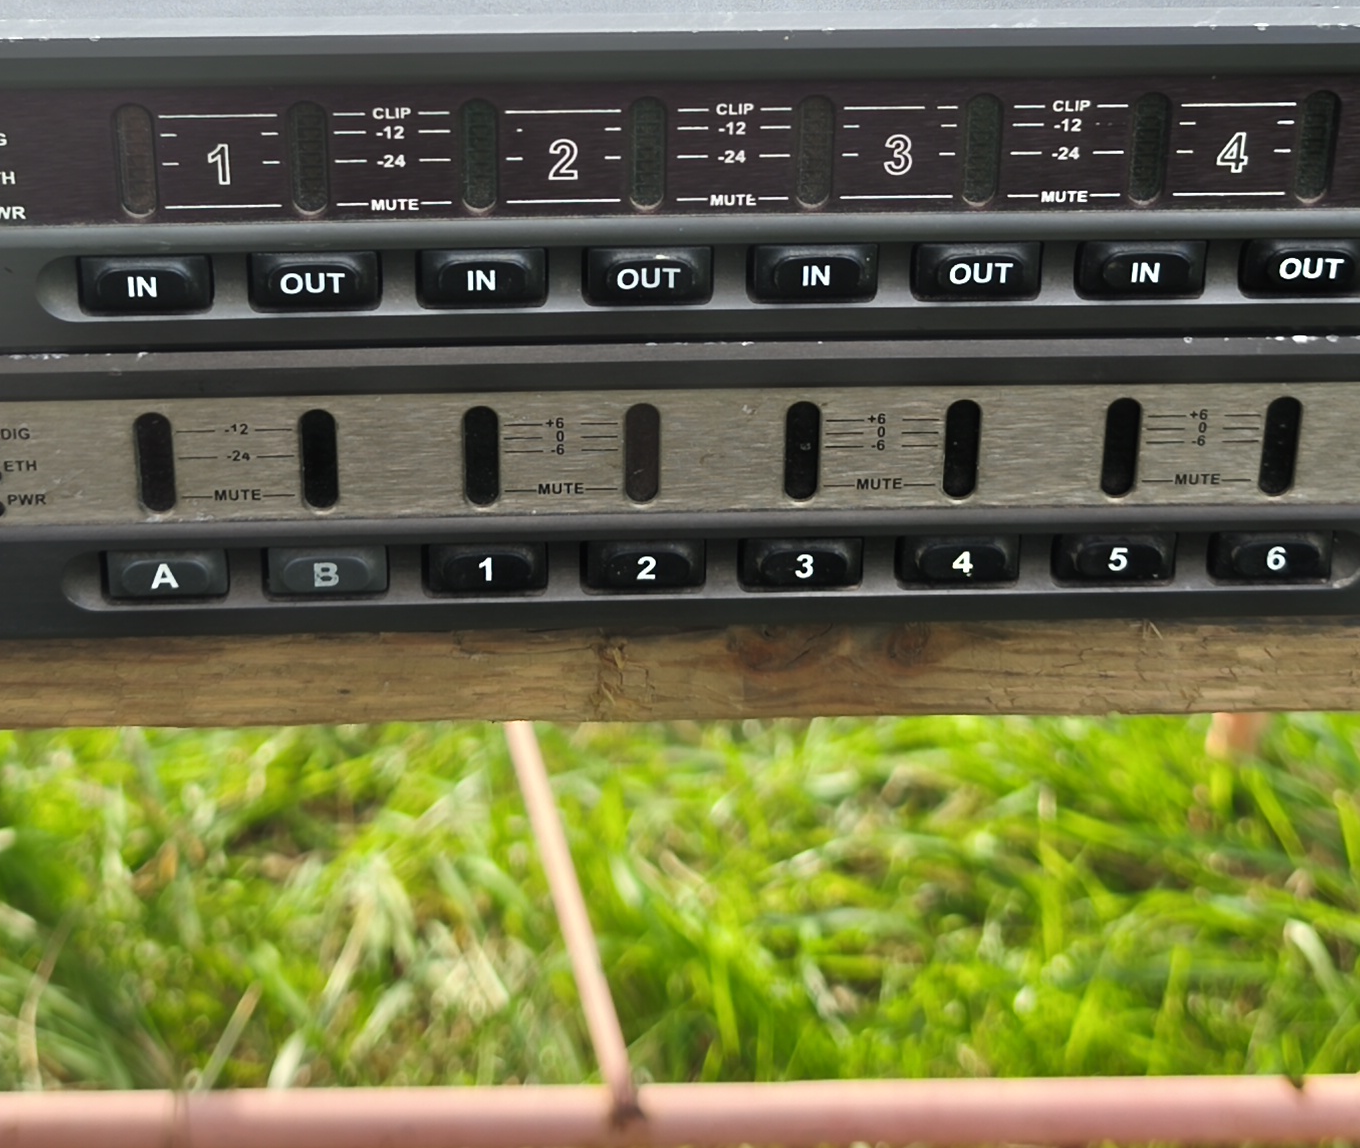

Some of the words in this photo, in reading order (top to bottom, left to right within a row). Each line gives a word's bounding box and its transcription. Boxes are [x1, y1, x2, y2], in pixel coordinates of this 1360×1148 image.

[715, 102, 754, 116] CLIP
[1052, 99, 1091, 113] CLIP
[372, 107, 412, 120] CLIP
[718, 121, 746, 135] -12
[1053, 118, 1082, 132] -12
[375, 125, 405, 140] -12
[548, 138, 579, 181] 2
[717, 149, 747, 164] -24
[883, 133, 913, 176] 3
[1051, 146, 1080, 161] -24
[1216, 131, 1249, 174] 4
[207, 143, 231, 186] 1
[376, 154, 406, 168] -24
[709, 193, 757, 207] MUTE
[1040, 190, 1089, 203] MUTE
[371, 198, 420, 211] MUTE
[802, 264, 831, 287] IN
[949, 262, 1014, 285] OUT
[1130, 262, 1161, 283] IN
[1279, 257, 1345, 280] OUT
[280, 272, 346, 295] OUT
[467, 269, 496, 291] IN
[616, 267, 681, 290] OUT
[127, 276, 158, 298] IN
[867, 412, 887, 425] +6
[1189, 408, 1209, 421] +6
[224, 423, 249, 436] -12
[545, 417, 565, 429] +6
[1198, 421, 1208, 434] 0
[0, 427, 31, 441] DIG
[555, 430, 565, 443] 0
[877, 425, 886, 438] 0
[870, 439, 886, 452] -6
[1191, 434, 1206, 447] -6
[226, 449, 251, 462] -24
[550, 443, 565, 456] -6
[3, 459, 38, 473] ETH
[856, 477, 903, 491] MUTE
[1174, 473, 1221, 486] MUTE
[214, 488, 262, 502] MUTE
[537, 482, 585, 495] MUTE
[6, 493, 47, 506] PWR
[952, 550, 974, 577] 4
[1108, 547, 1128, 572] 5
[1266, 546, 1286, 571] 6
[478, 557, 493, 582] 1
[636, 555, 657, 580] 2
[794, 553, 814, 579] 3
[151, 563, 179, 590] A
[313, 562, 340, 588] B
